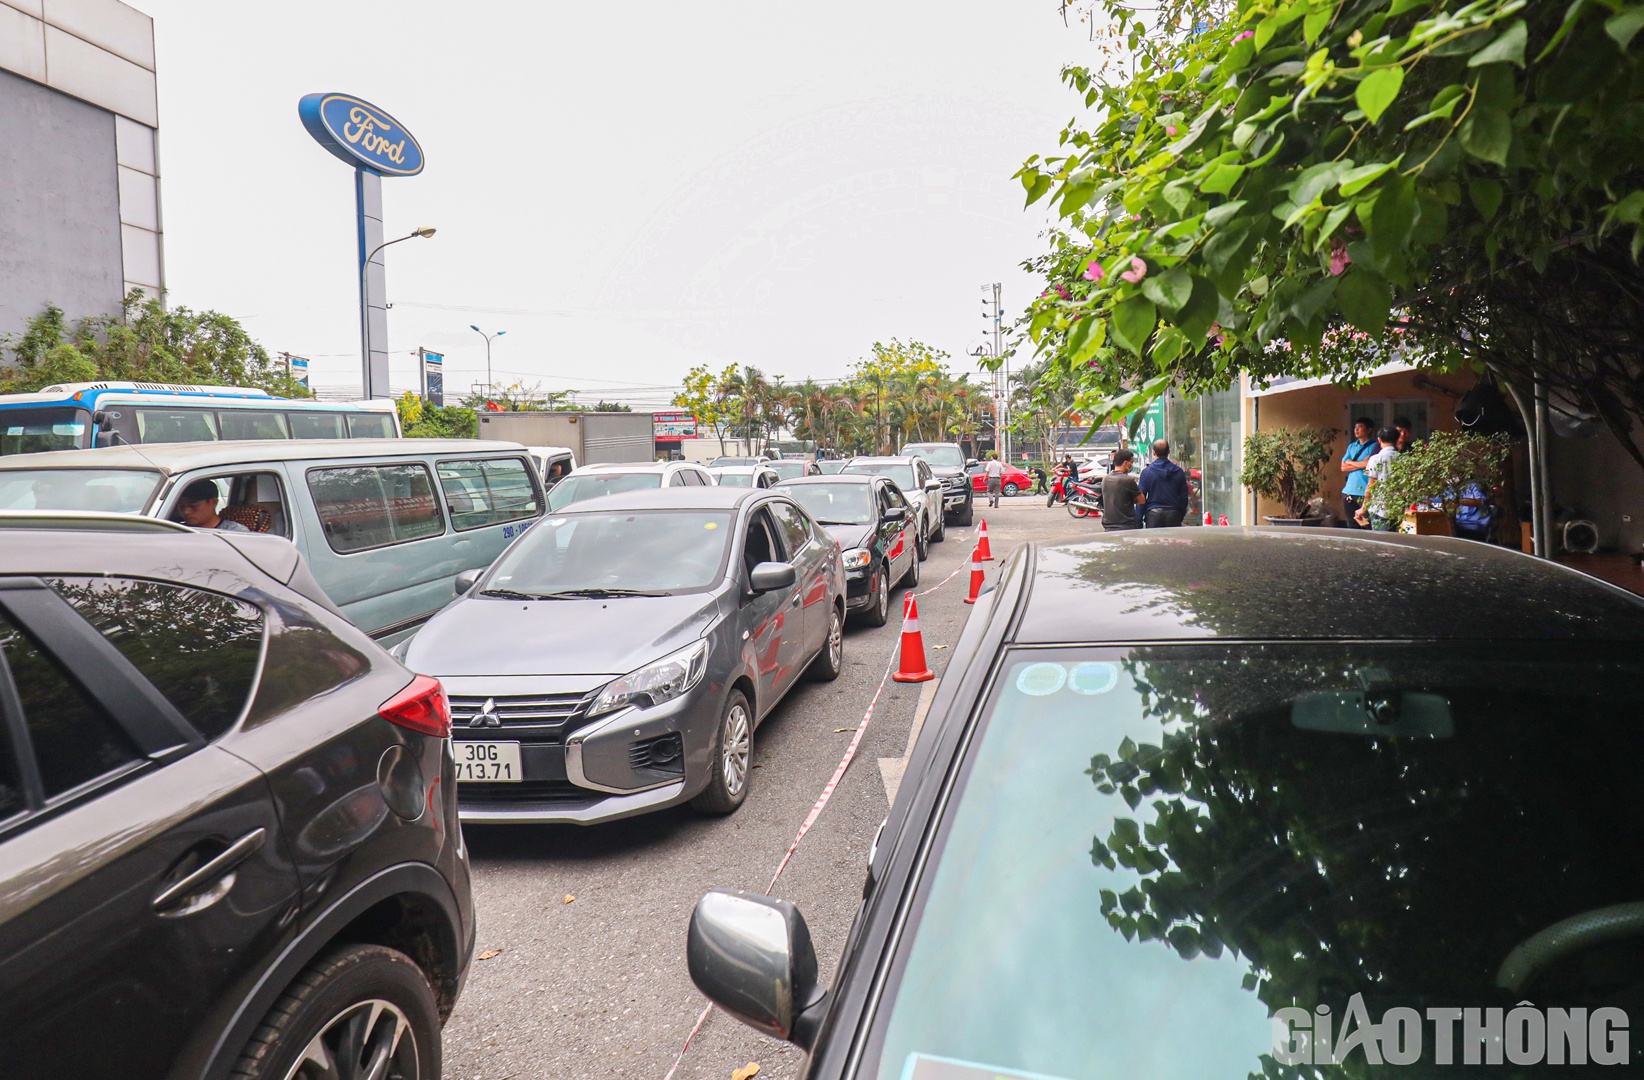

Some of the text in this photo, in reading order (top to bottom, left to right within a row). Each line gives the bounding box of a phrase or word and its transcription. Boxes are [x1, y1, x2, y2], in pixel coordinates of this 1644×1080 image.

[344, 106, 406, 165] Ford
[465, 744, 498, 761] 30G
[455, 763, 512, 780] 713.71
